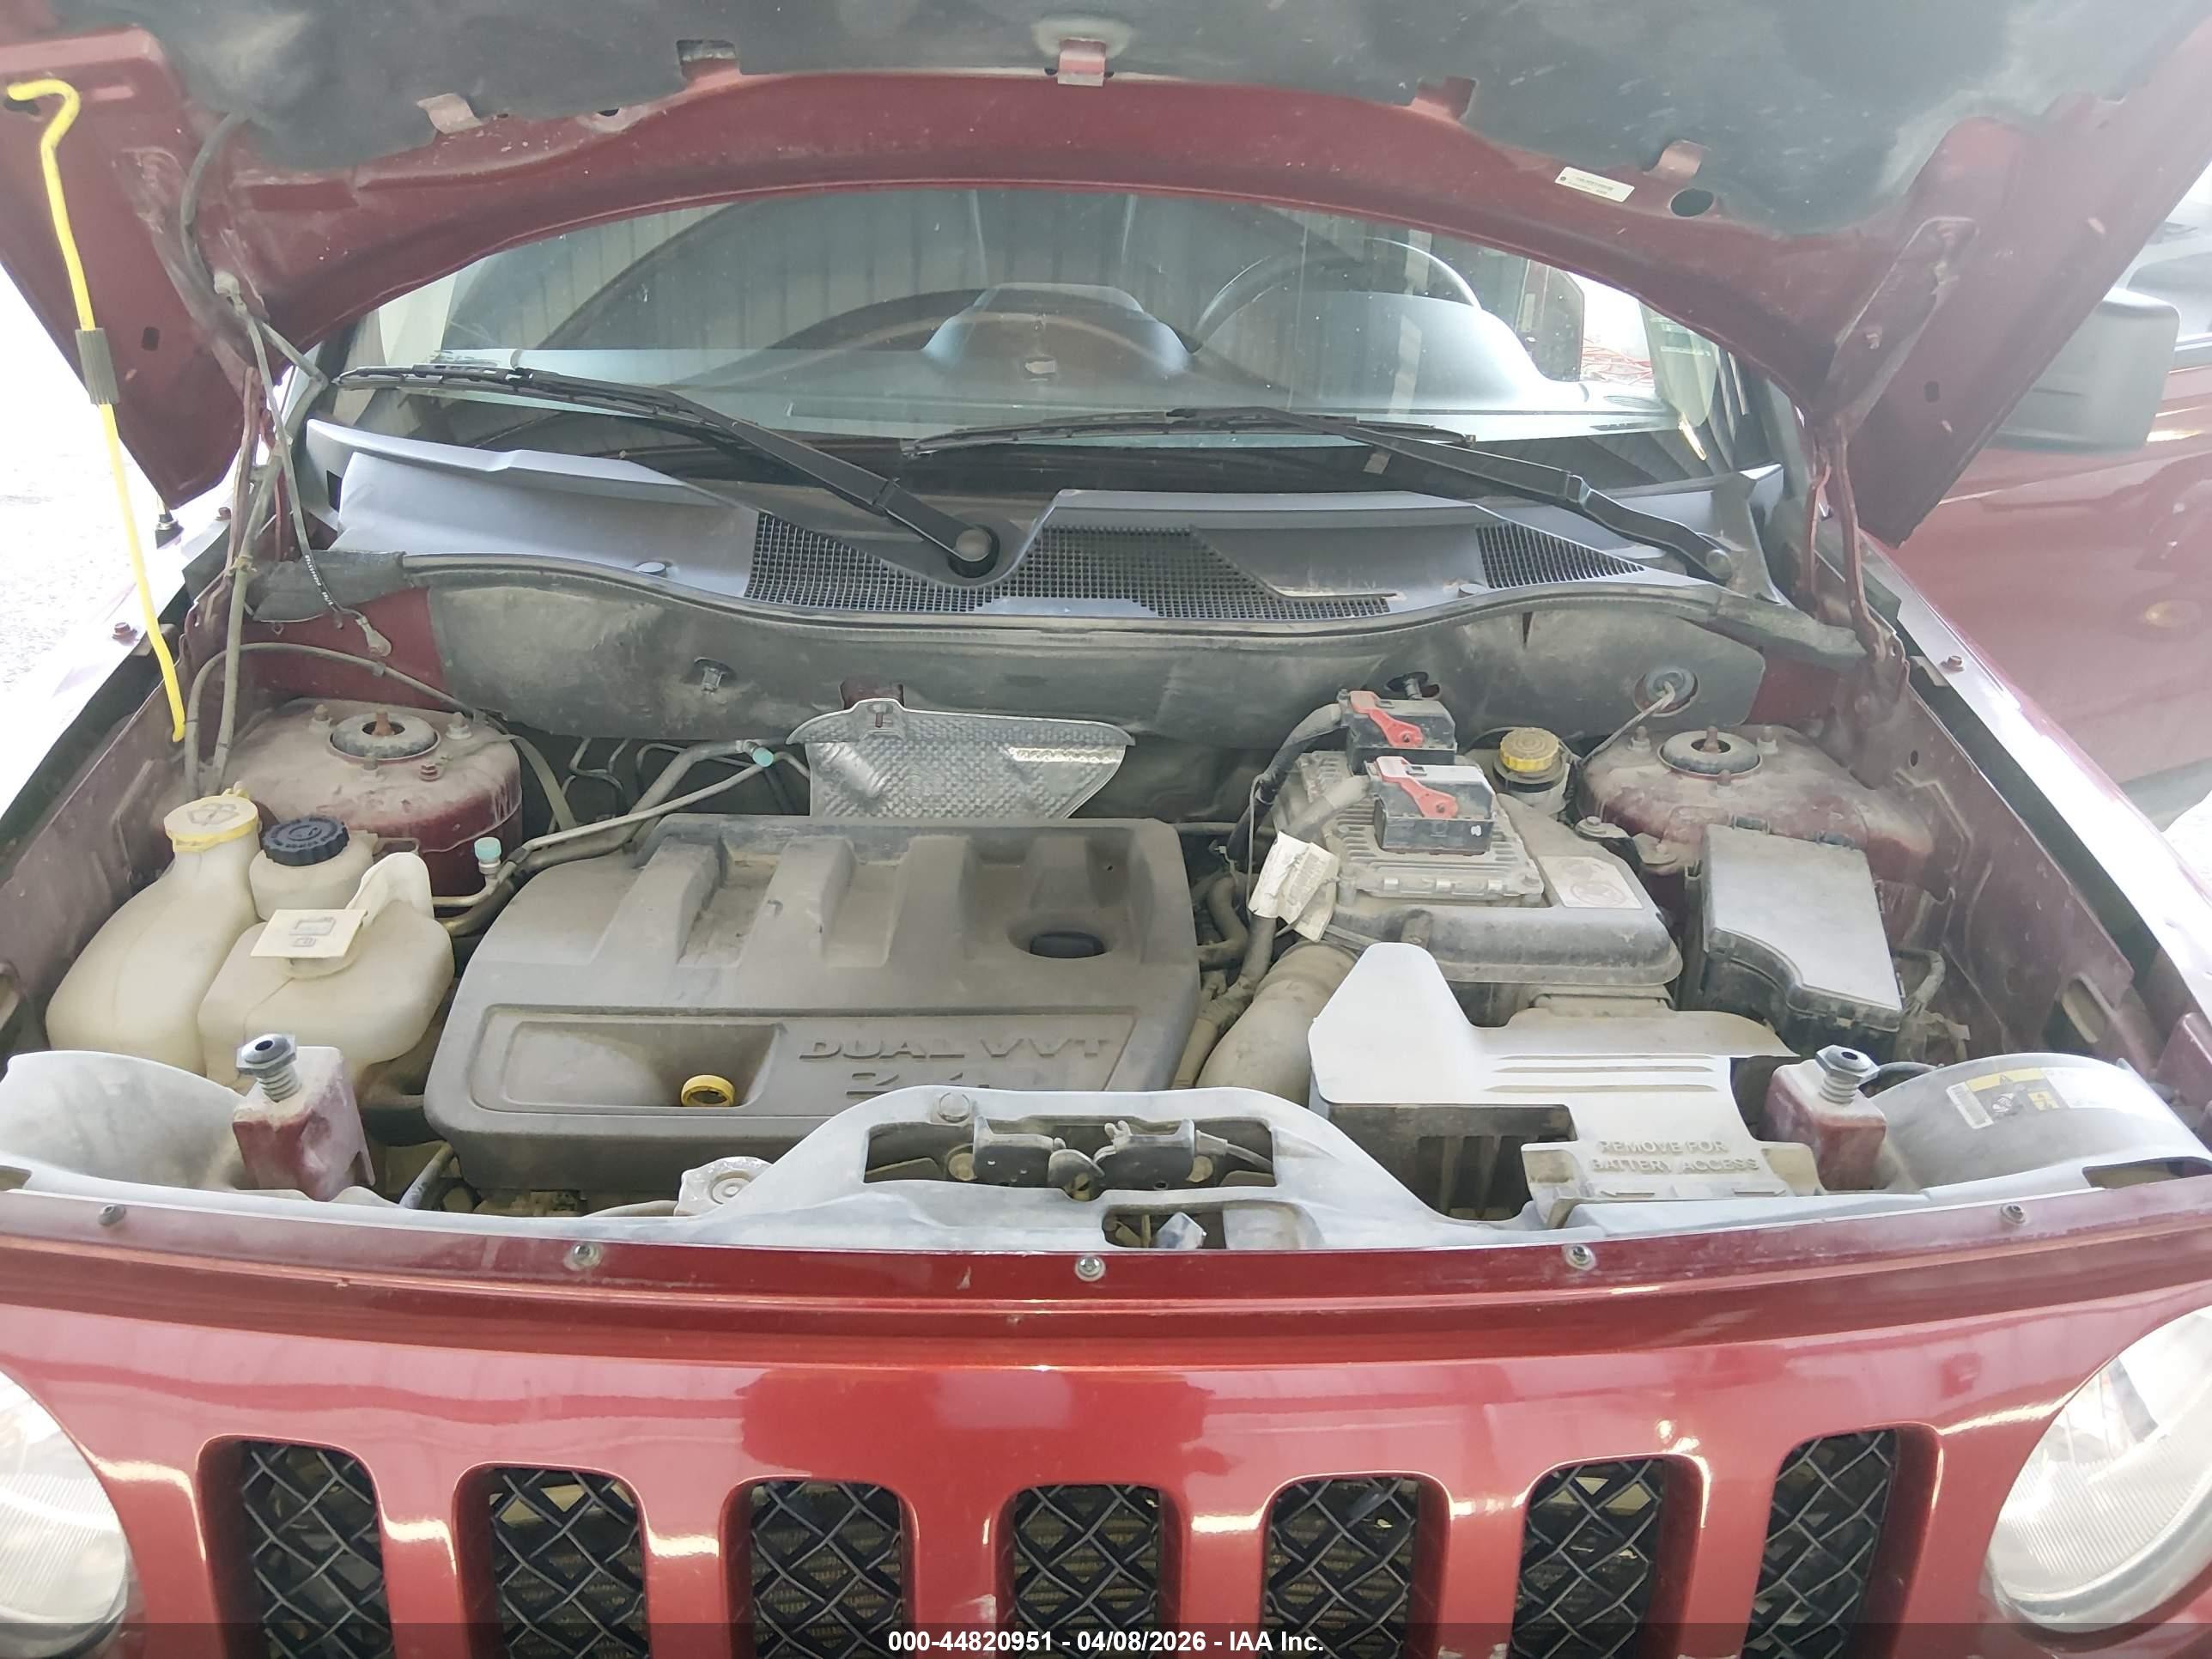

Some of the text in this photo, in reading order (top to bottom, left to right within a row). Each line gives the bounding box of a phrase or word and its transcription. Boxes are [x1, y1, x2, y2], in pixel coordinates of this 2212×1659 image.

[799, 1037, 1109, 1060] DUAL VVT
[1599, 1139, 1729, 1156] REMOVE FOR
[1592, 1158, 1760, 1174] BATTERY ACCESS
